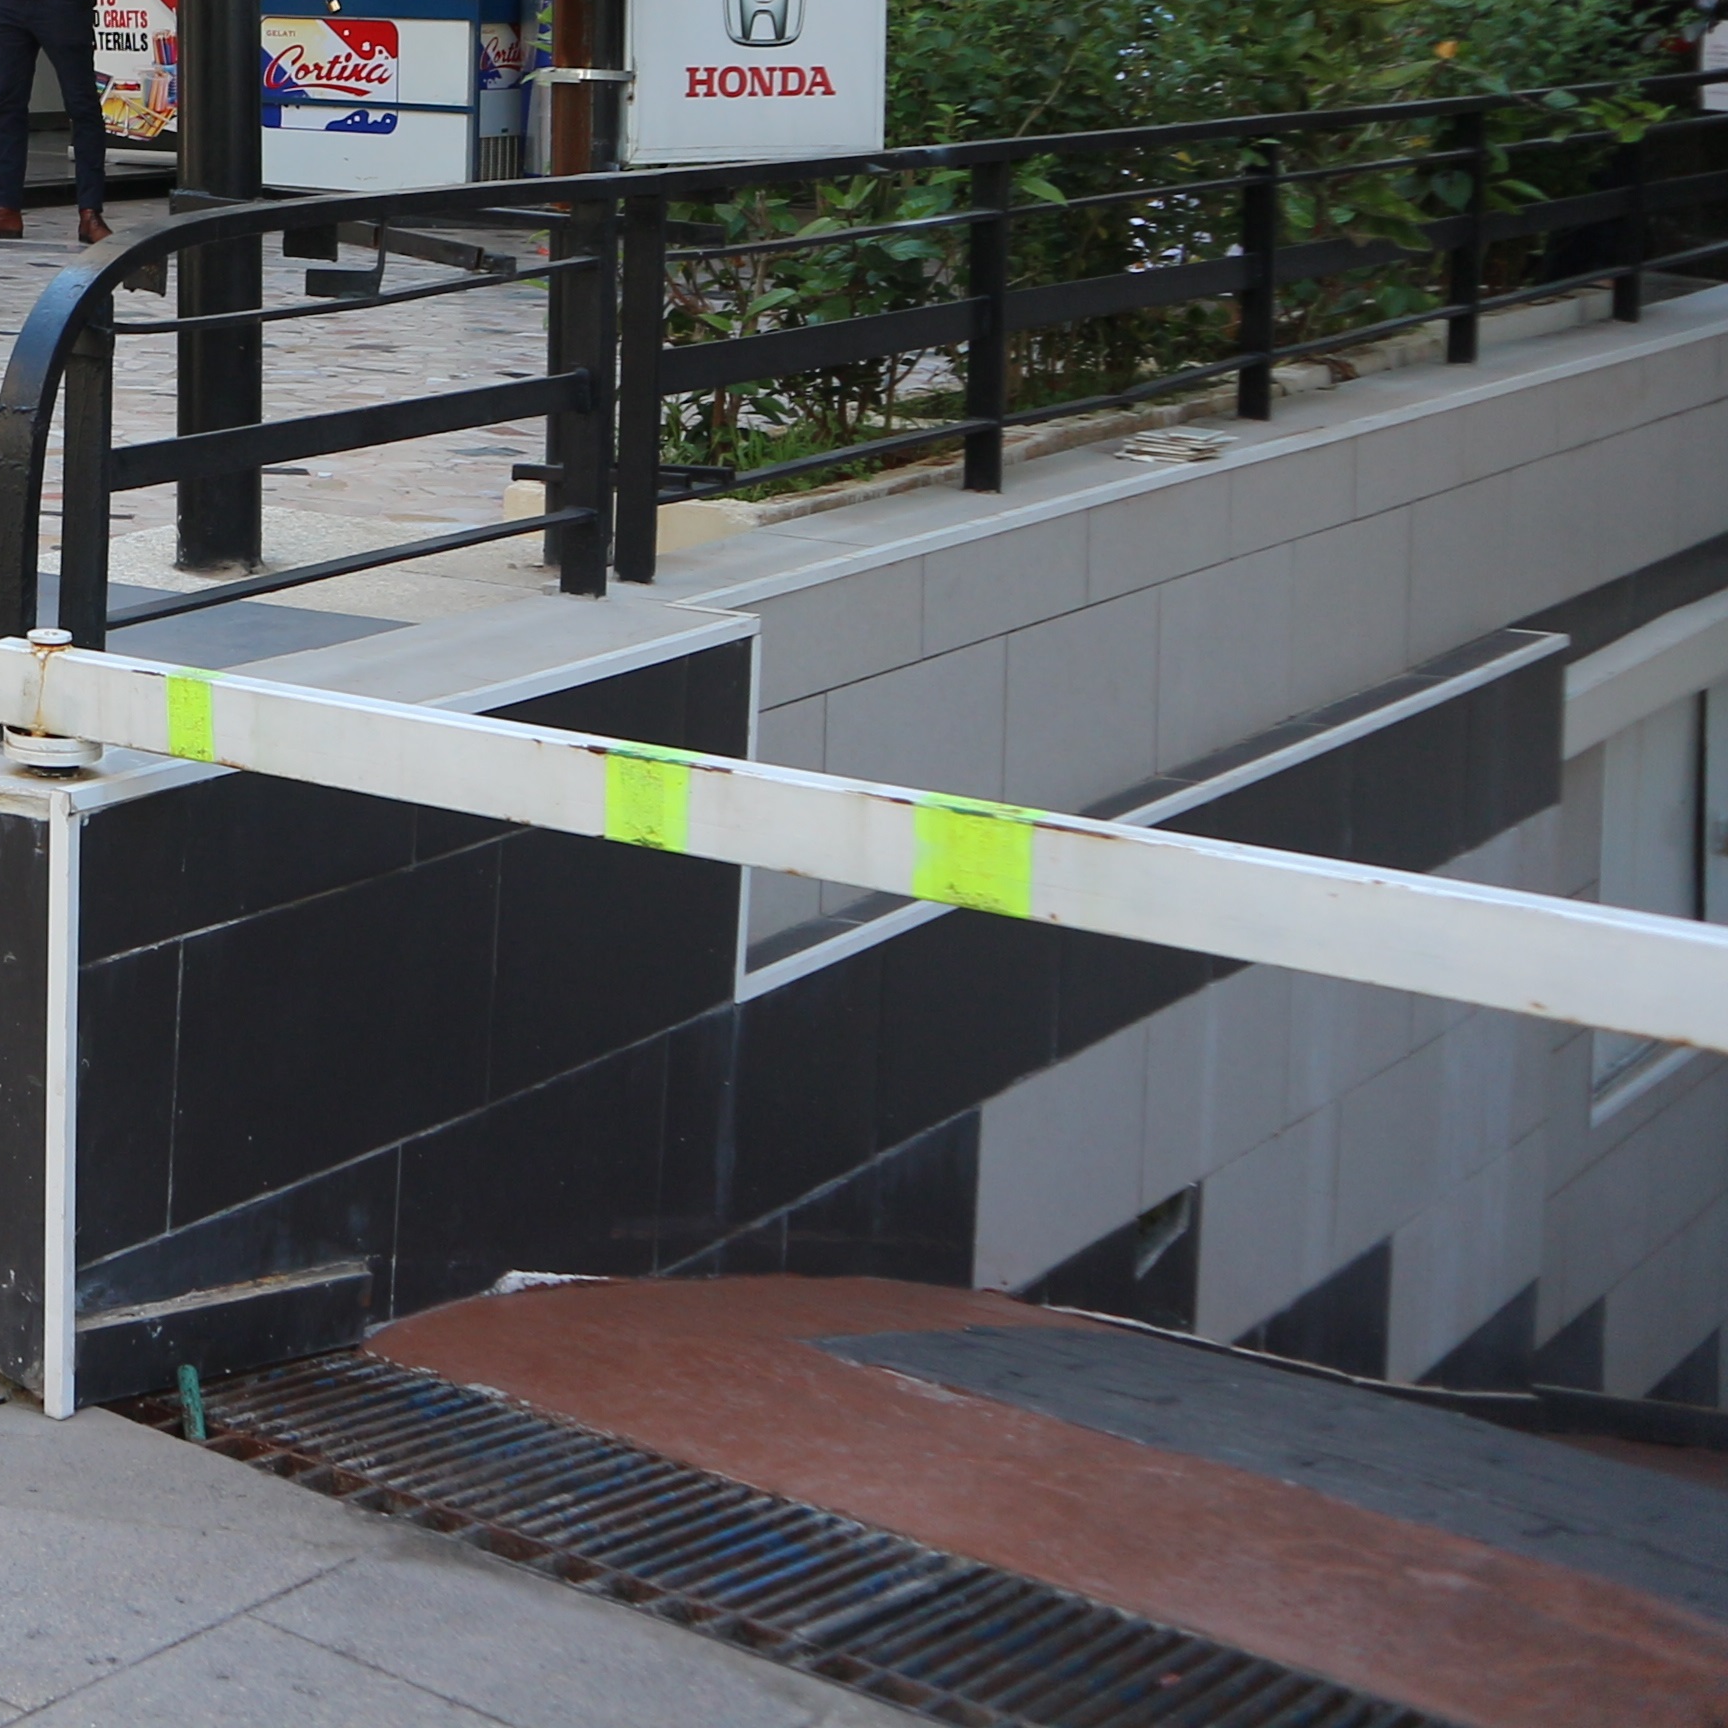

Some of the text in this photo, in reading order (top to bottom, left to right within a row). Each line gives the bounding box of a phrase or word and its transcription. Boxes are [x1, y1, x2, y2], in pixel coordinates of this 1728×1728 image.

[104, 10, 147, 28] CRAFTS
[266, 29, 296, 37] GELATI
[264, 44, 394, 89] Cortina
[685, 66, 836, 98] HONDA
